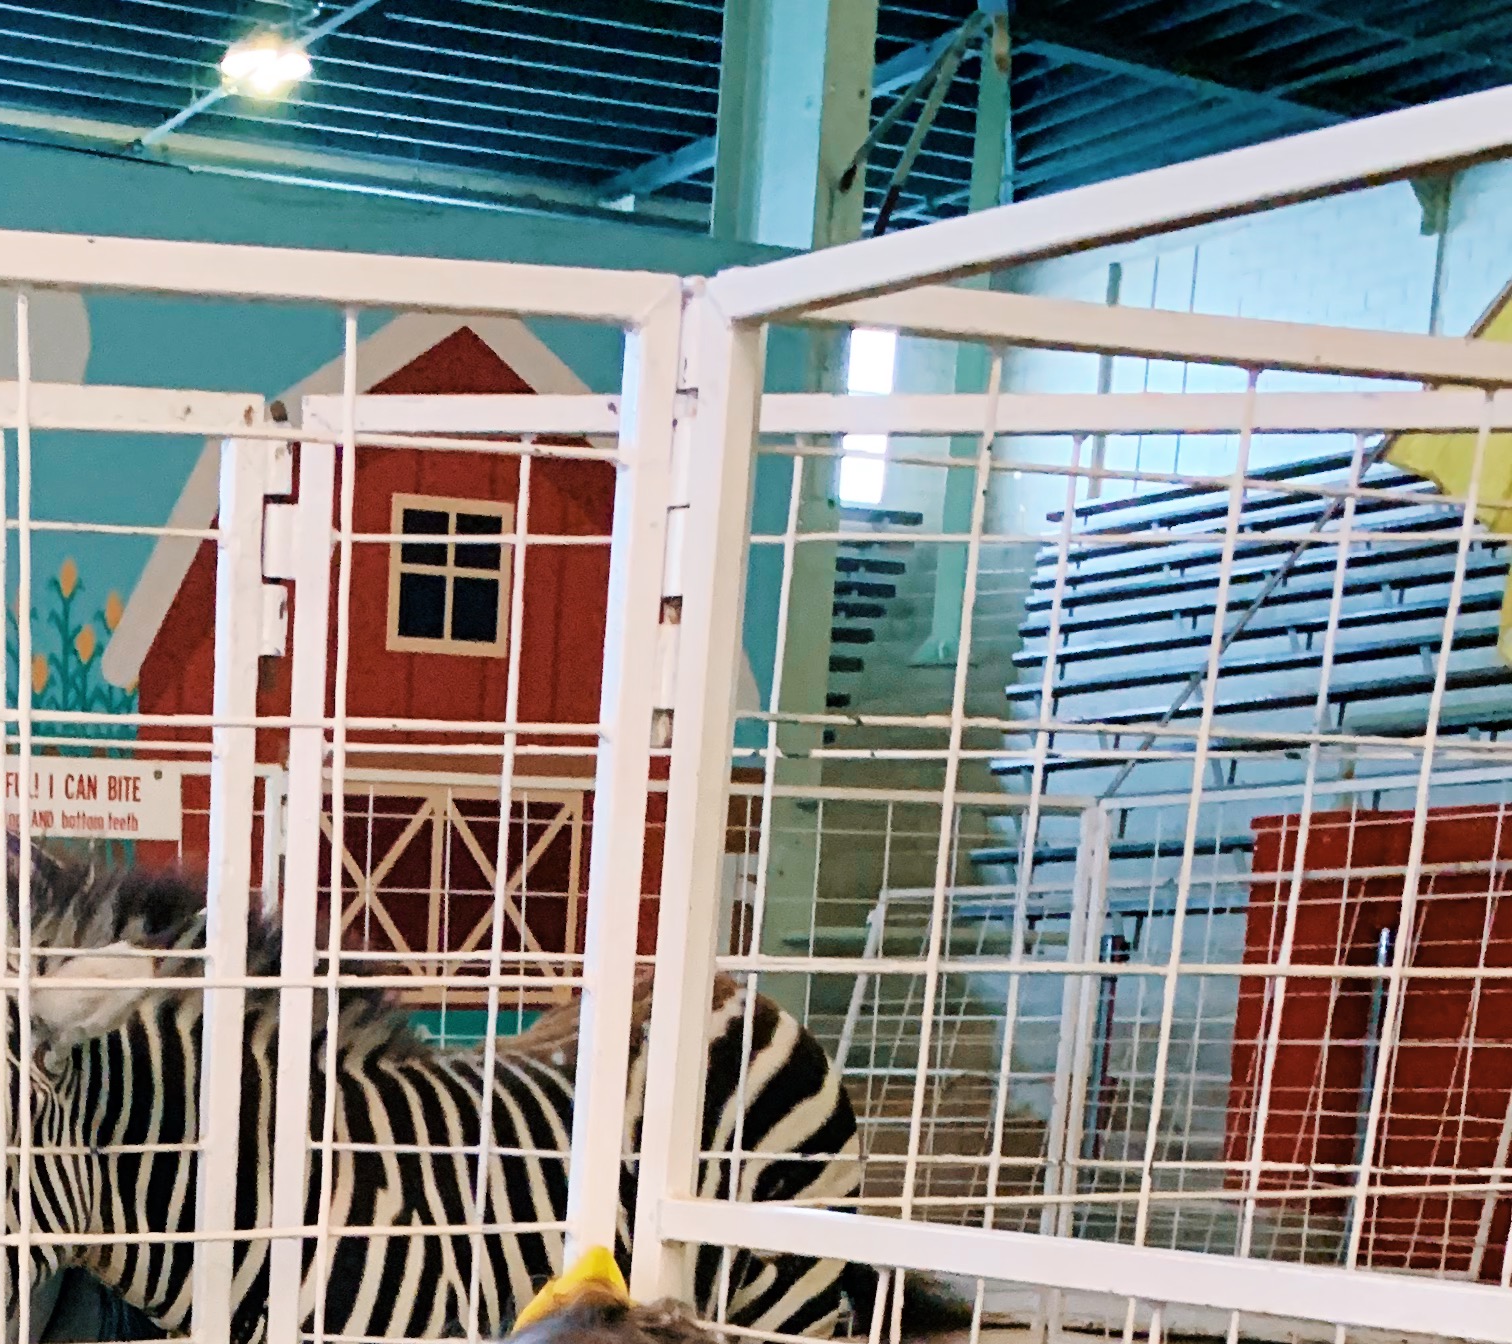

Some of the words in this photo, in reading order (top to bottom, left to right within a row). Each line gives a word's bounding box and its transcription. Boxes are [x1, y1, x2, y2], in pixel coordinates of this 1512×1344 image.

[49, 773, 54, 799] I
[64, 772, 97, 800] CAN
[107, 775, 141, 802] BITE
[31, 809, 54, 828] AND
[61, 810, 105, 830] bottom
[108, 812, 139, 832] teeth
